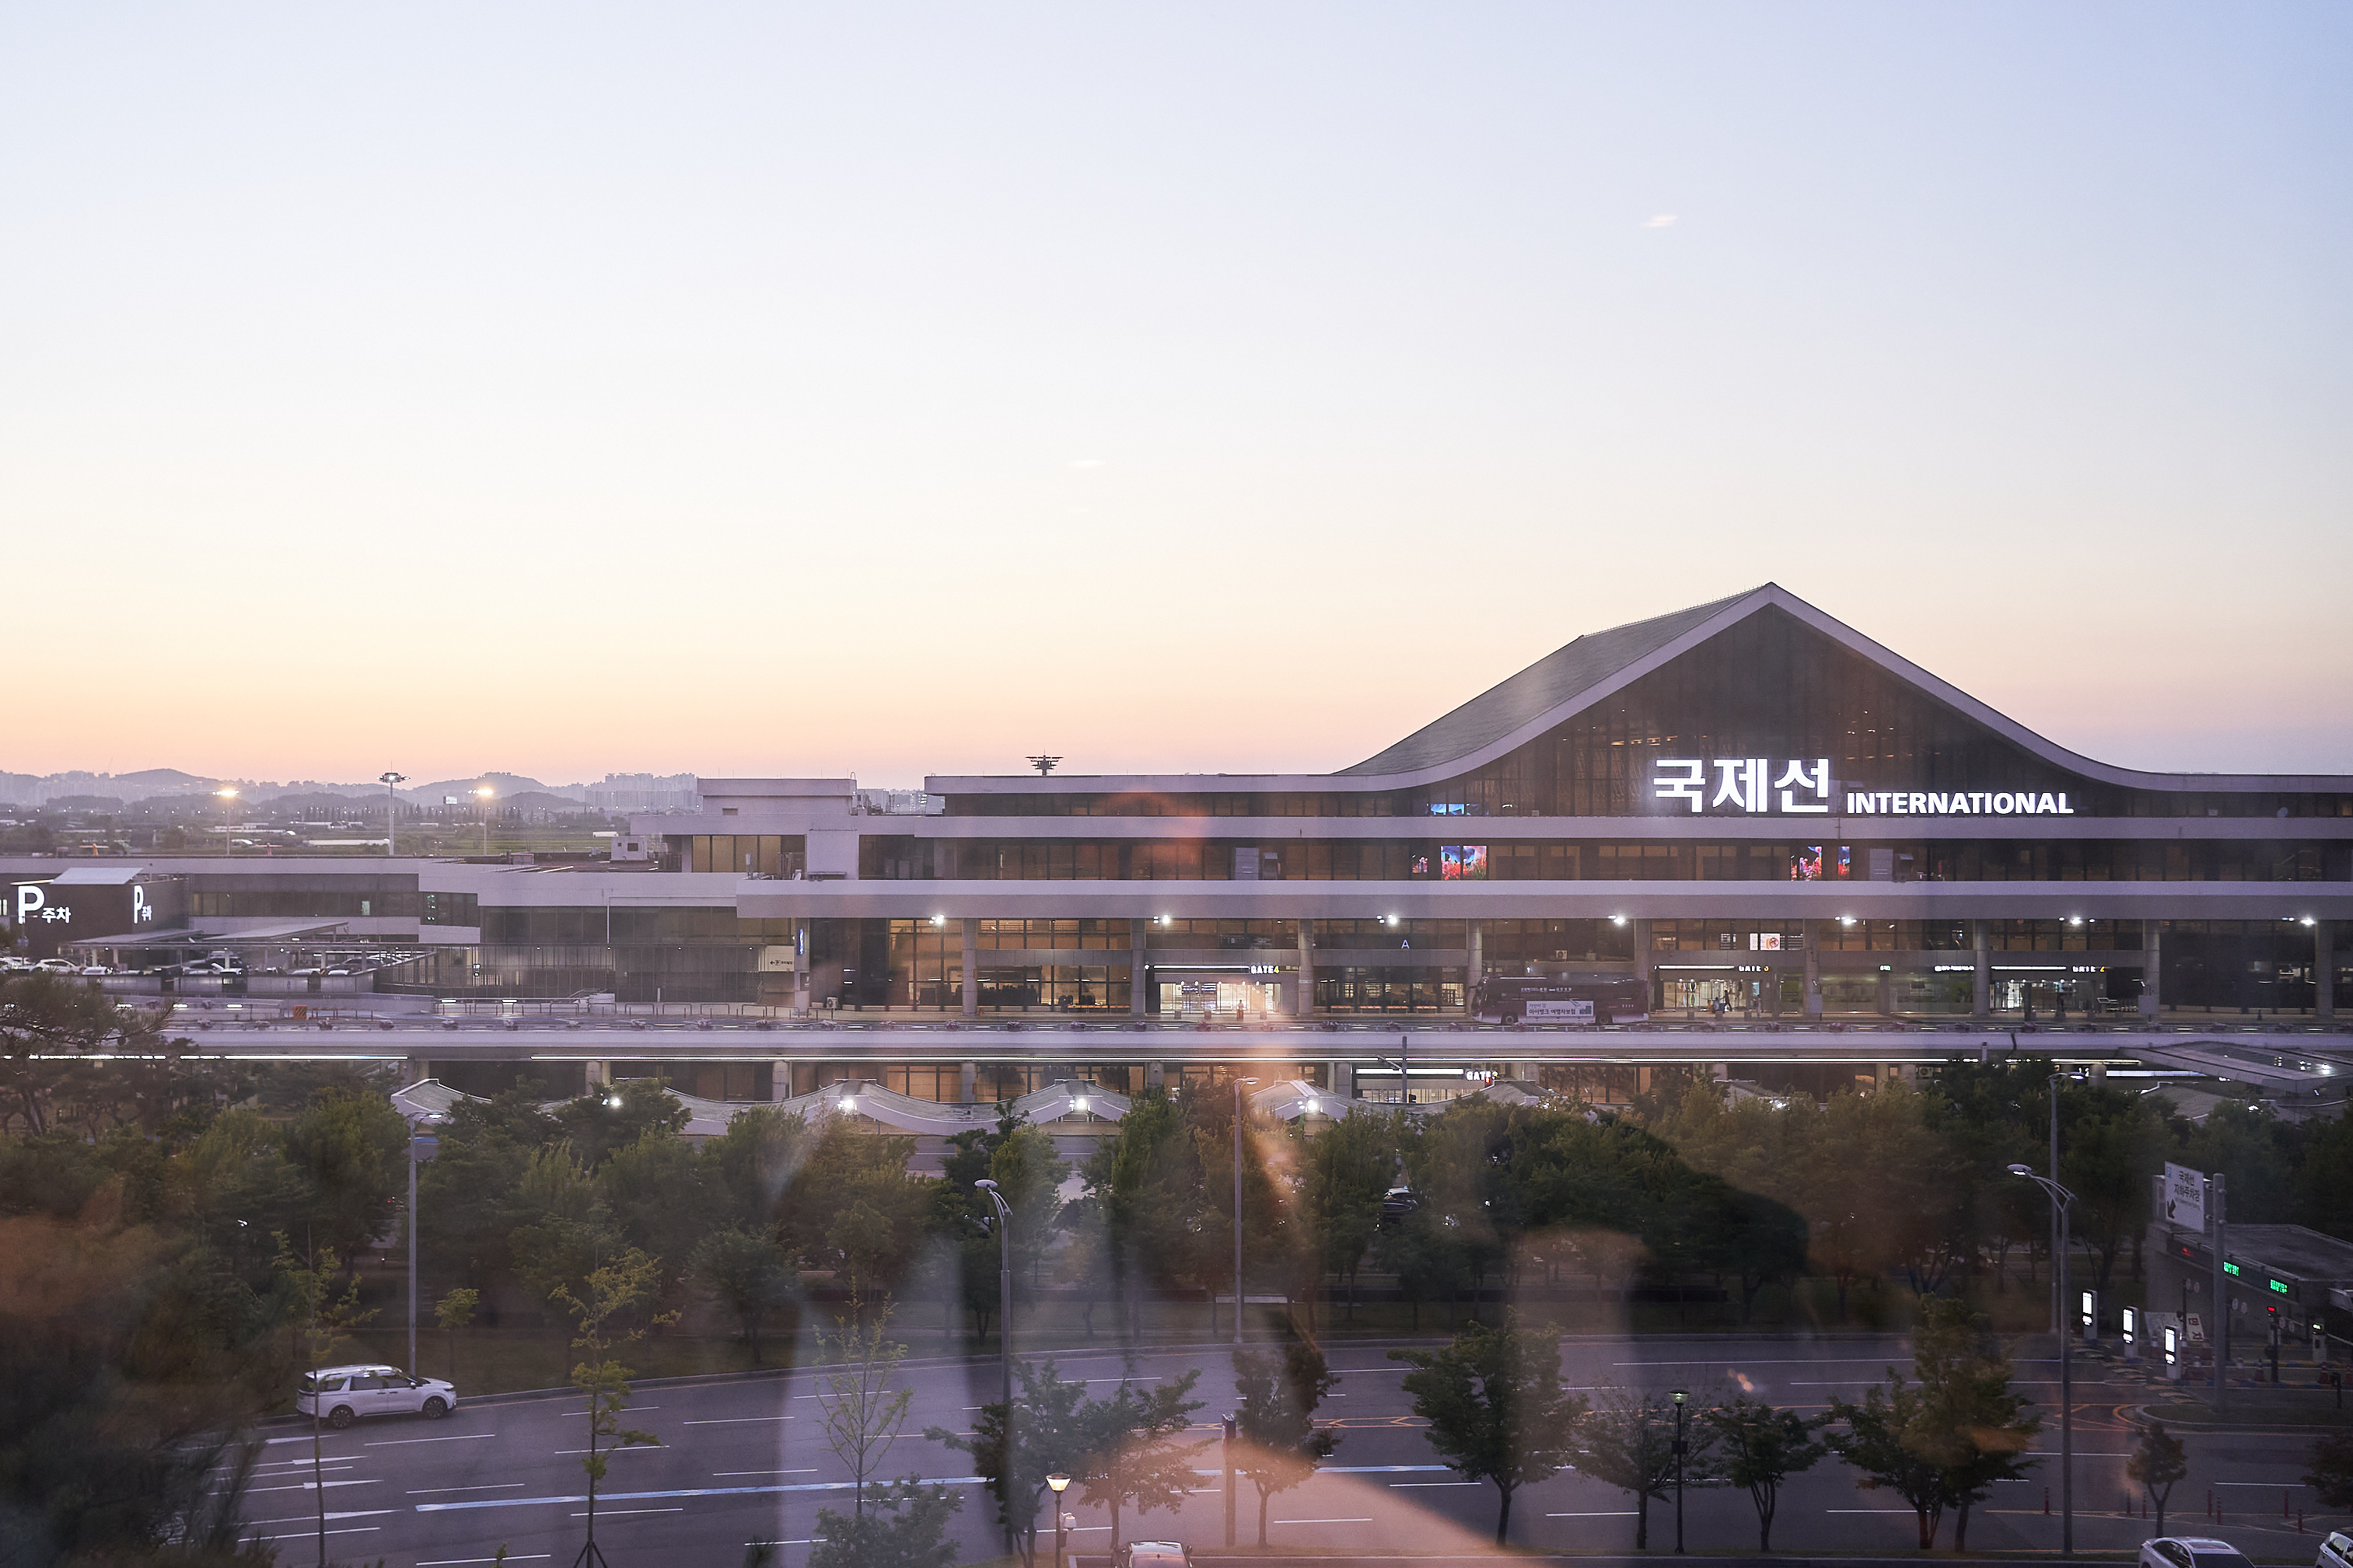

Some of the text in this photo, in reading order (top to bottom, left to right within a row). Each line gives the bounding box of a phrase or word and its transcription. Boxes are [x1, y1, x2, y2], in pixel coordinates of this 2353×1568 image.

[1653, 758, 1829, 813] 국제선
[1847, 791, 2075, 814] INTERNATIONAL
[18, 885, 72, 924] P 주차
[134, 885, 152, 924] P 주차
[1400, 939, 1410, 949] A
[2179, 1170, 2195, 1186] 국제선
[2173, 1183, 2200, 1202] 지하주차장
